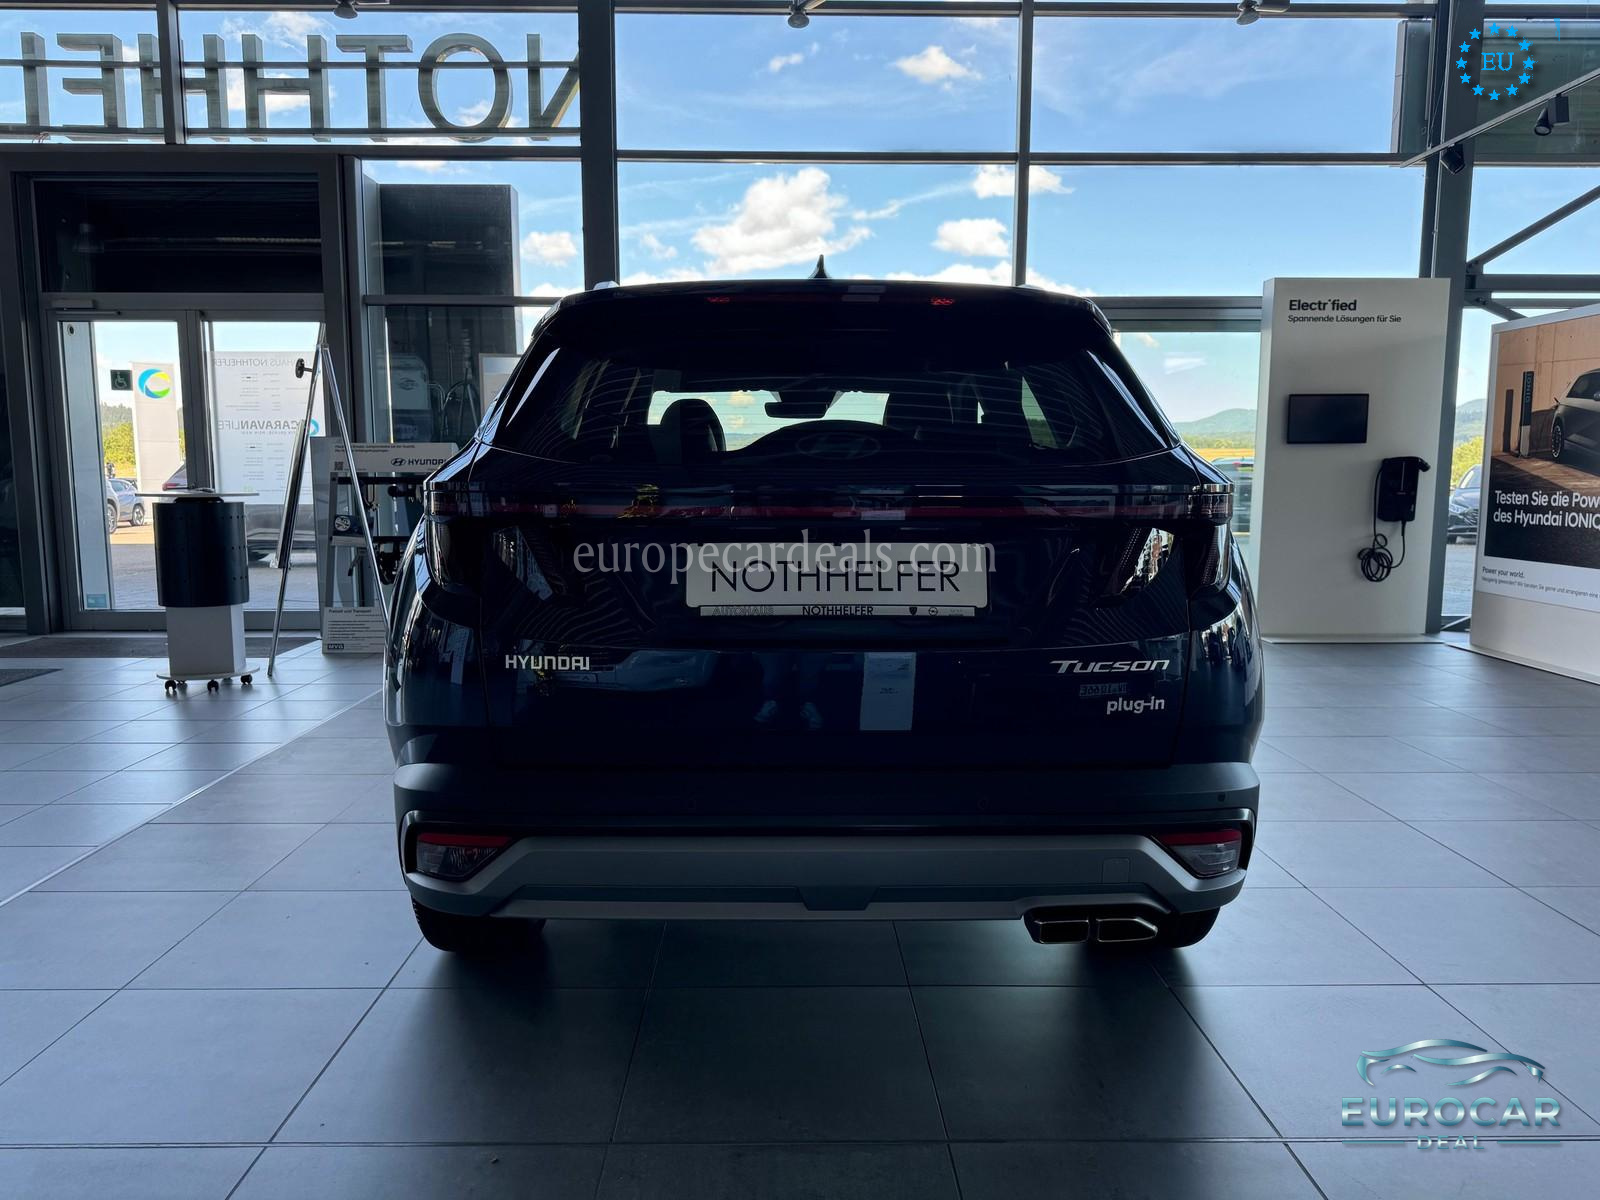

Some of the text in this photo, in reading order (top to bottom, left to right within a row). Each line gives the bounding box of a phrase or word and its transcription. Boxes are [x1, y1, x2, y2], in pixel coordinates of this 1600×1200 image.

[1288, 314, 1402, 324] Spannende Lösungen für Sie
[408, 458, 446, 466] HYUNDA
[1495, 490, 1600, 508] Testen Sie die Pow
[1493, 508, 1512, 523] des
[1514, 510, 1563, 527] Hyundai
[711, 560, 960, 592] NOTHHELFER
[1482, 566, 1497, 575] Power
[1498, 568, 1508, 577] your
[802, 606, 874, 616] NOTHHELFER
[505, 655, 590, 670] HYUNDAI
[1107, 696, 1165, 715] plug-in
